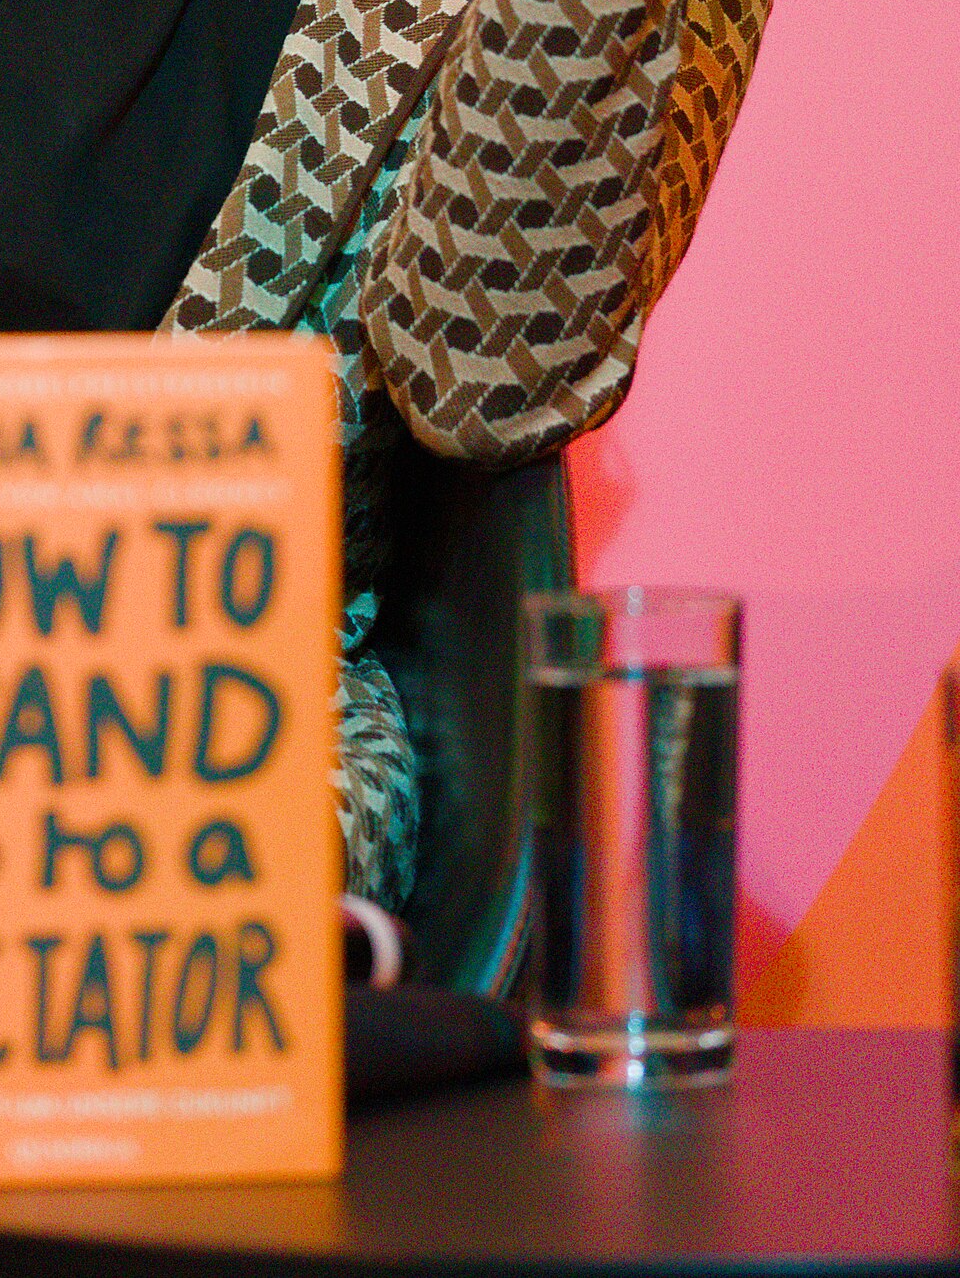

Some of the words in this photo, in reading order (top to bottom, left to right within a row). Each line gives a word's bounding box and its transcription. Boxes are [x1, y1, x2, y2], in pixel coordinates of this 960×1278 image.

[150, 517, 279, 632] TO
[37, 809, 150, 897] to
[183, 815, 260, 891] a
